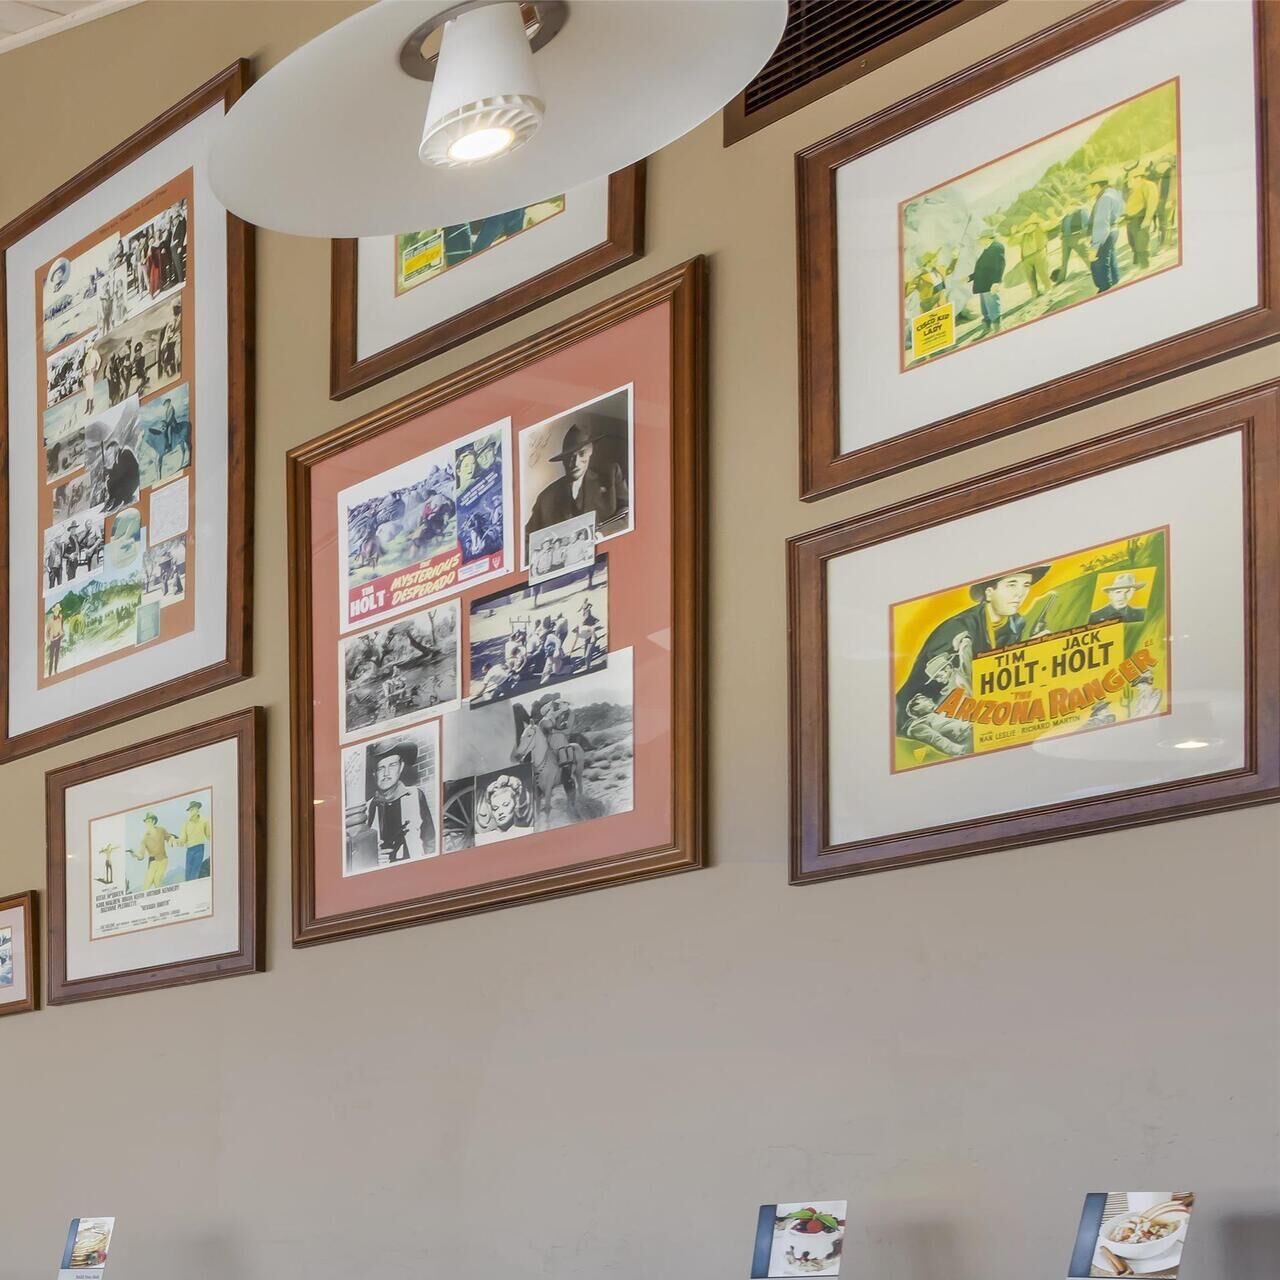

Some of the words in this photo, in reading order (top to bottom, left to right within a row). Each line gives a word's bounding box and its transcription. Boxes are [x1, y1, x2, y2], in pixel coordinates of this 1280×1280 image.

[391, 553, 461, 592] MYSTERIOUS
[391, 571, 456, 606] DESPERADO
[350, 590, 386, 618] HOLT
[980, 660, 1039, 695] HOLT
[1051, 641, 1114, 678] HOLT
[995, 650, 1025, 668] TIM
[1062, 631, 1101, 651] JACK
[934, 688, 1045, 725] ARIZONA
[1048, 649, 1158, 719] RANGER
[1021, 722, 1051, 734] RICHARD
[1052, 715, 1080, 727] MARTIN
